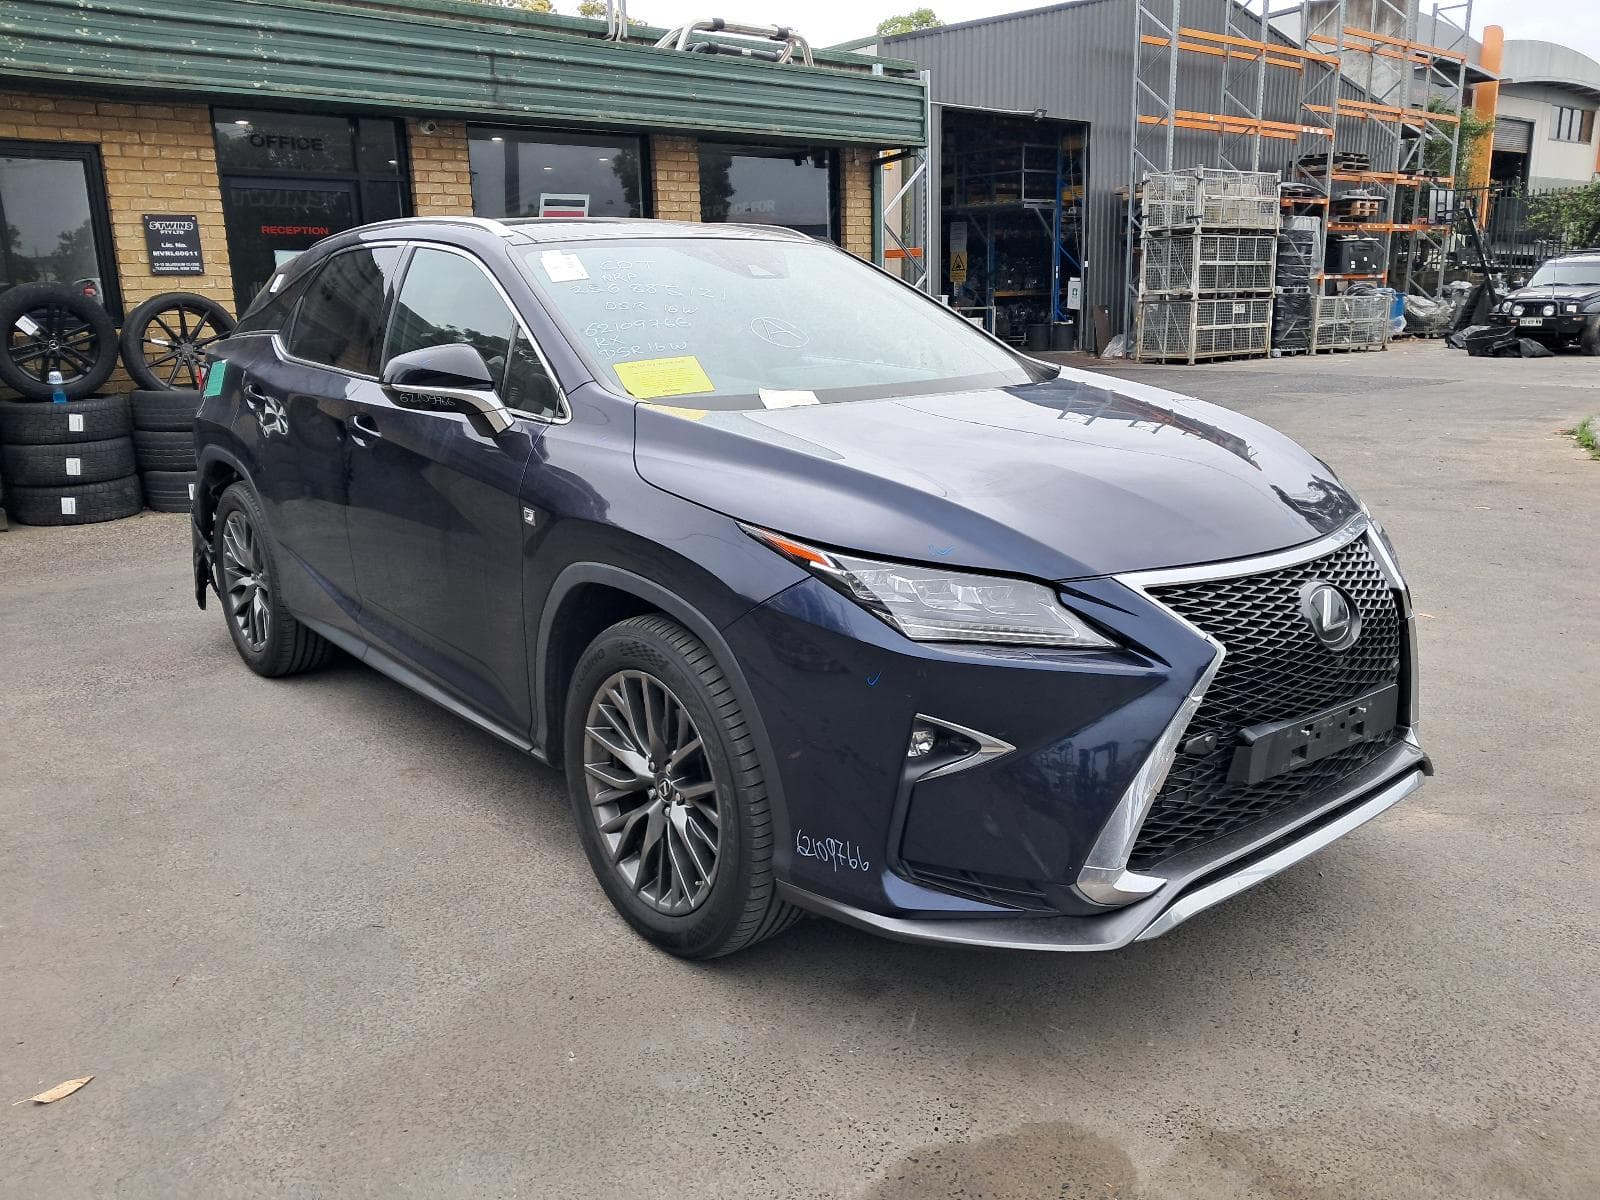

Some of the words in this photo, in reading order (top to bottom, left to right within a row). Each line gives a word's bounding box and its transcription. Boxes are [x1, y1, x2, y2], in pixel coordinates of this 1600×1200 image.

[249, 133, 324, 151] OFFICE
[261, 225, 329, 235] RECEPTION
[796, 829, 870, 873] 62109766
